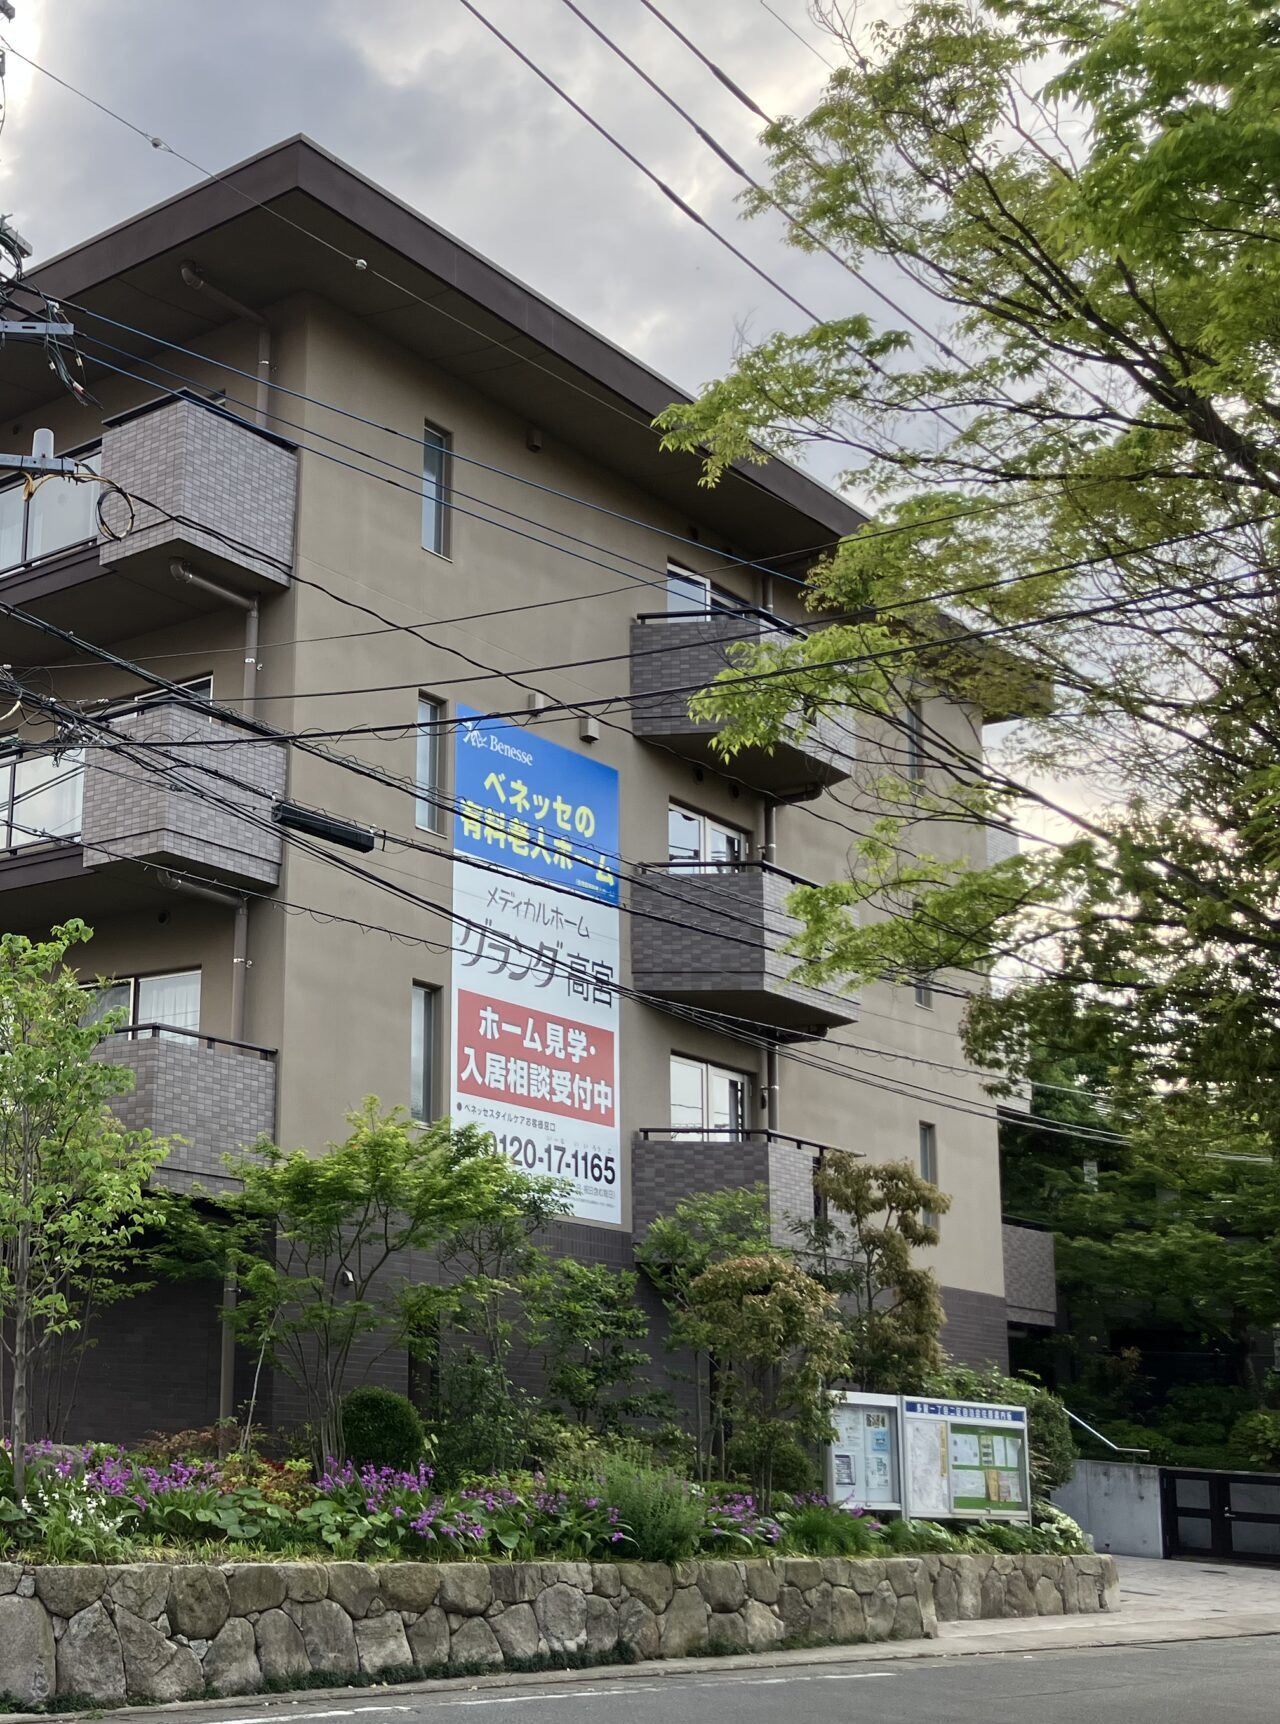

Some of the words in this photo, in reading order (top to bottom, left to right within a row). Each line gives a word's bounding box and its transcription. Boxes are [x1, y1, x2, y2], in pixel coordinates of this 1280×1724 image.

[489, 735, 533, 766] Benesse
[483, 771, 595, 838] ベネッセの
[460, 799, 615, 886] 有料老人ホーム
[486, 886, 590, 938] メディカルホーム
[460, 1046, 613, 1115] 入居相談受付中
